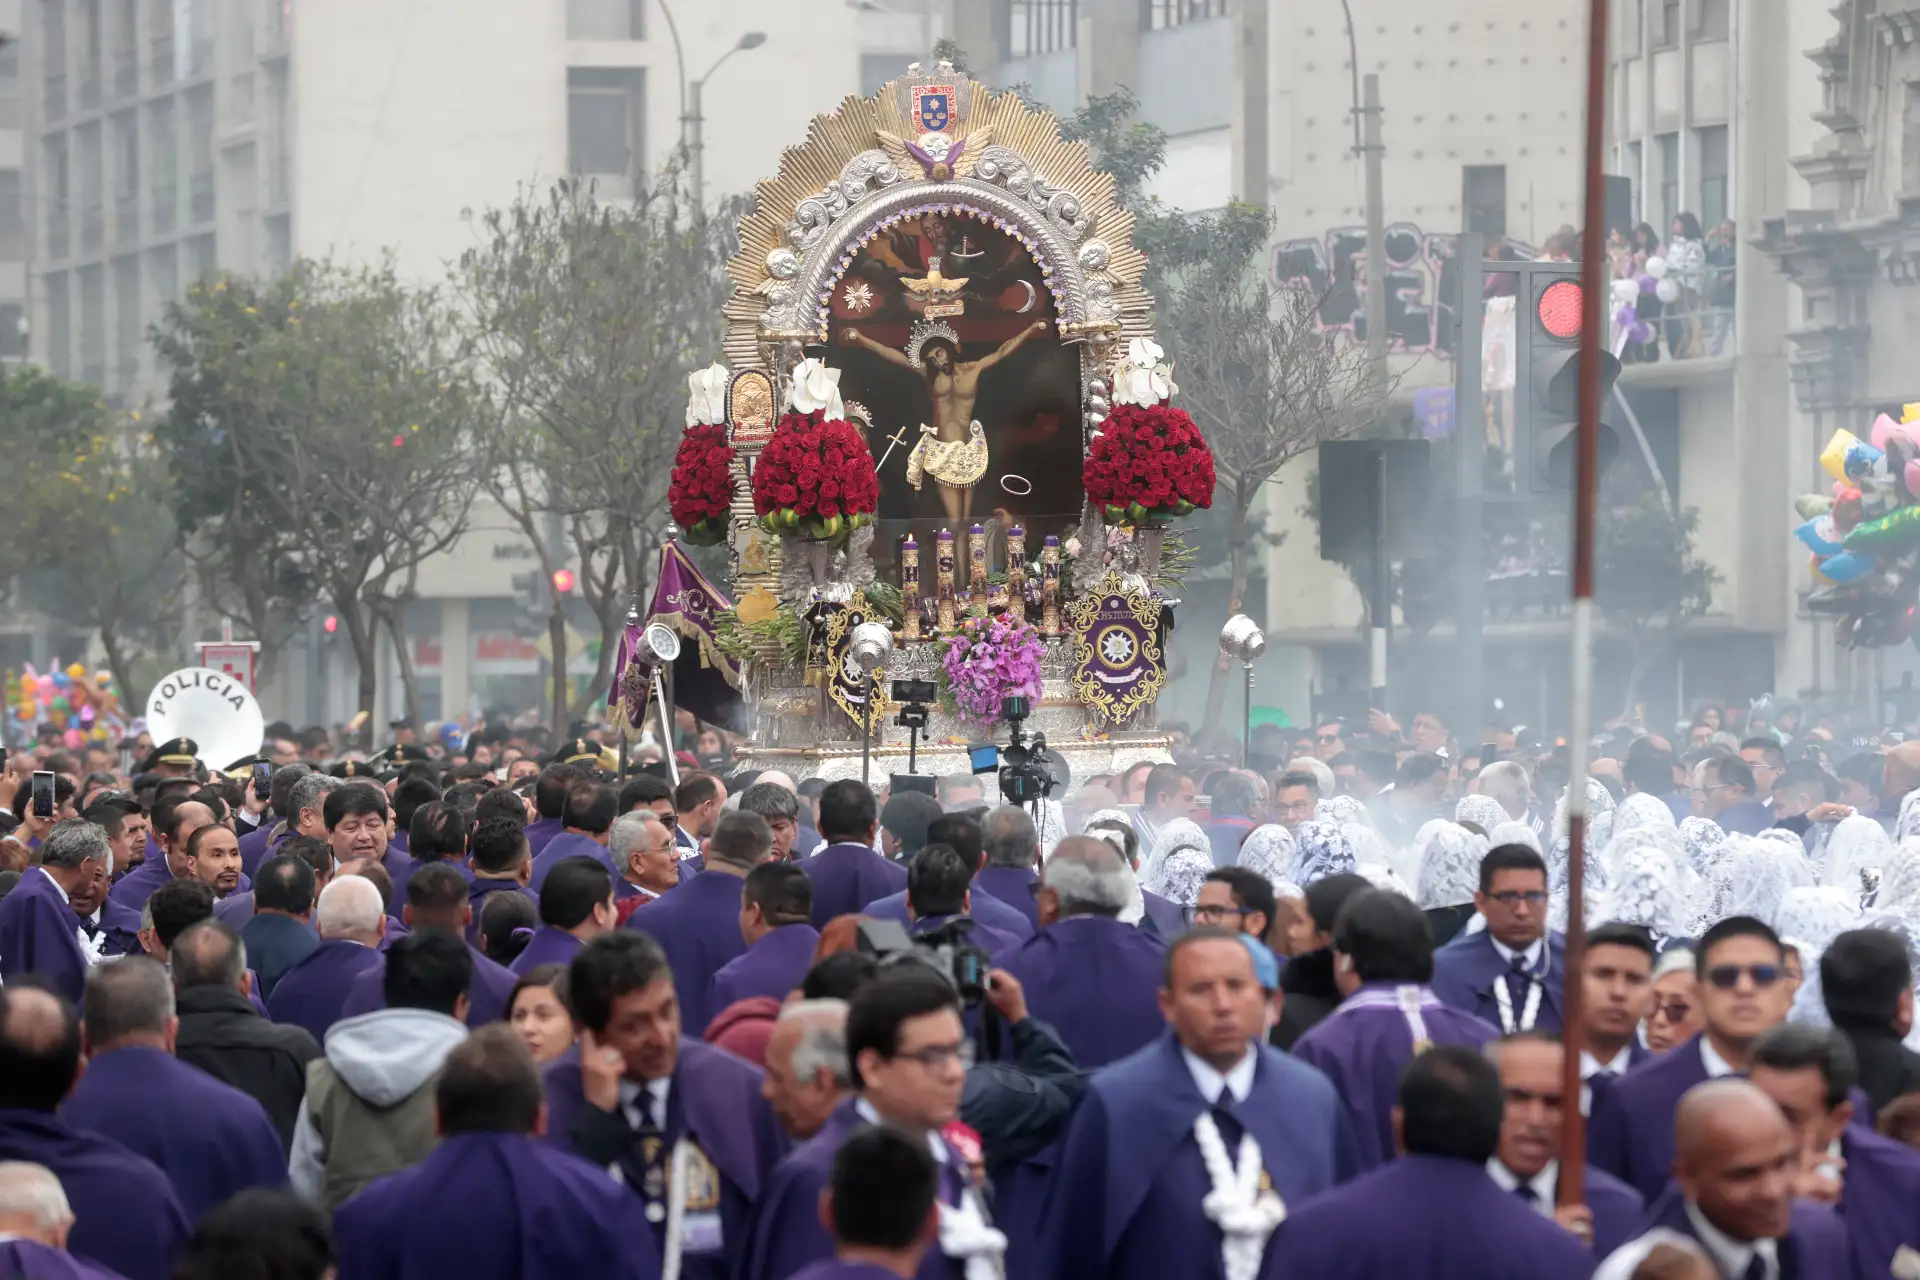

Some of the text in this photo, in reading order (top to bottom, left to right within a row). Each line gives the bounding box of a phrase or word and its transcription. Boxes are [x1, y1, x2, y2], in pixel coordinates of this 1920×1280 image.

[940, 557, 953, 572] S
[1011, 553, 1024, 568] M
[904, 566, 918, 581] H
[1045, 563, 1060, 578] N
[153, 671, 245, 716] POLICIA
